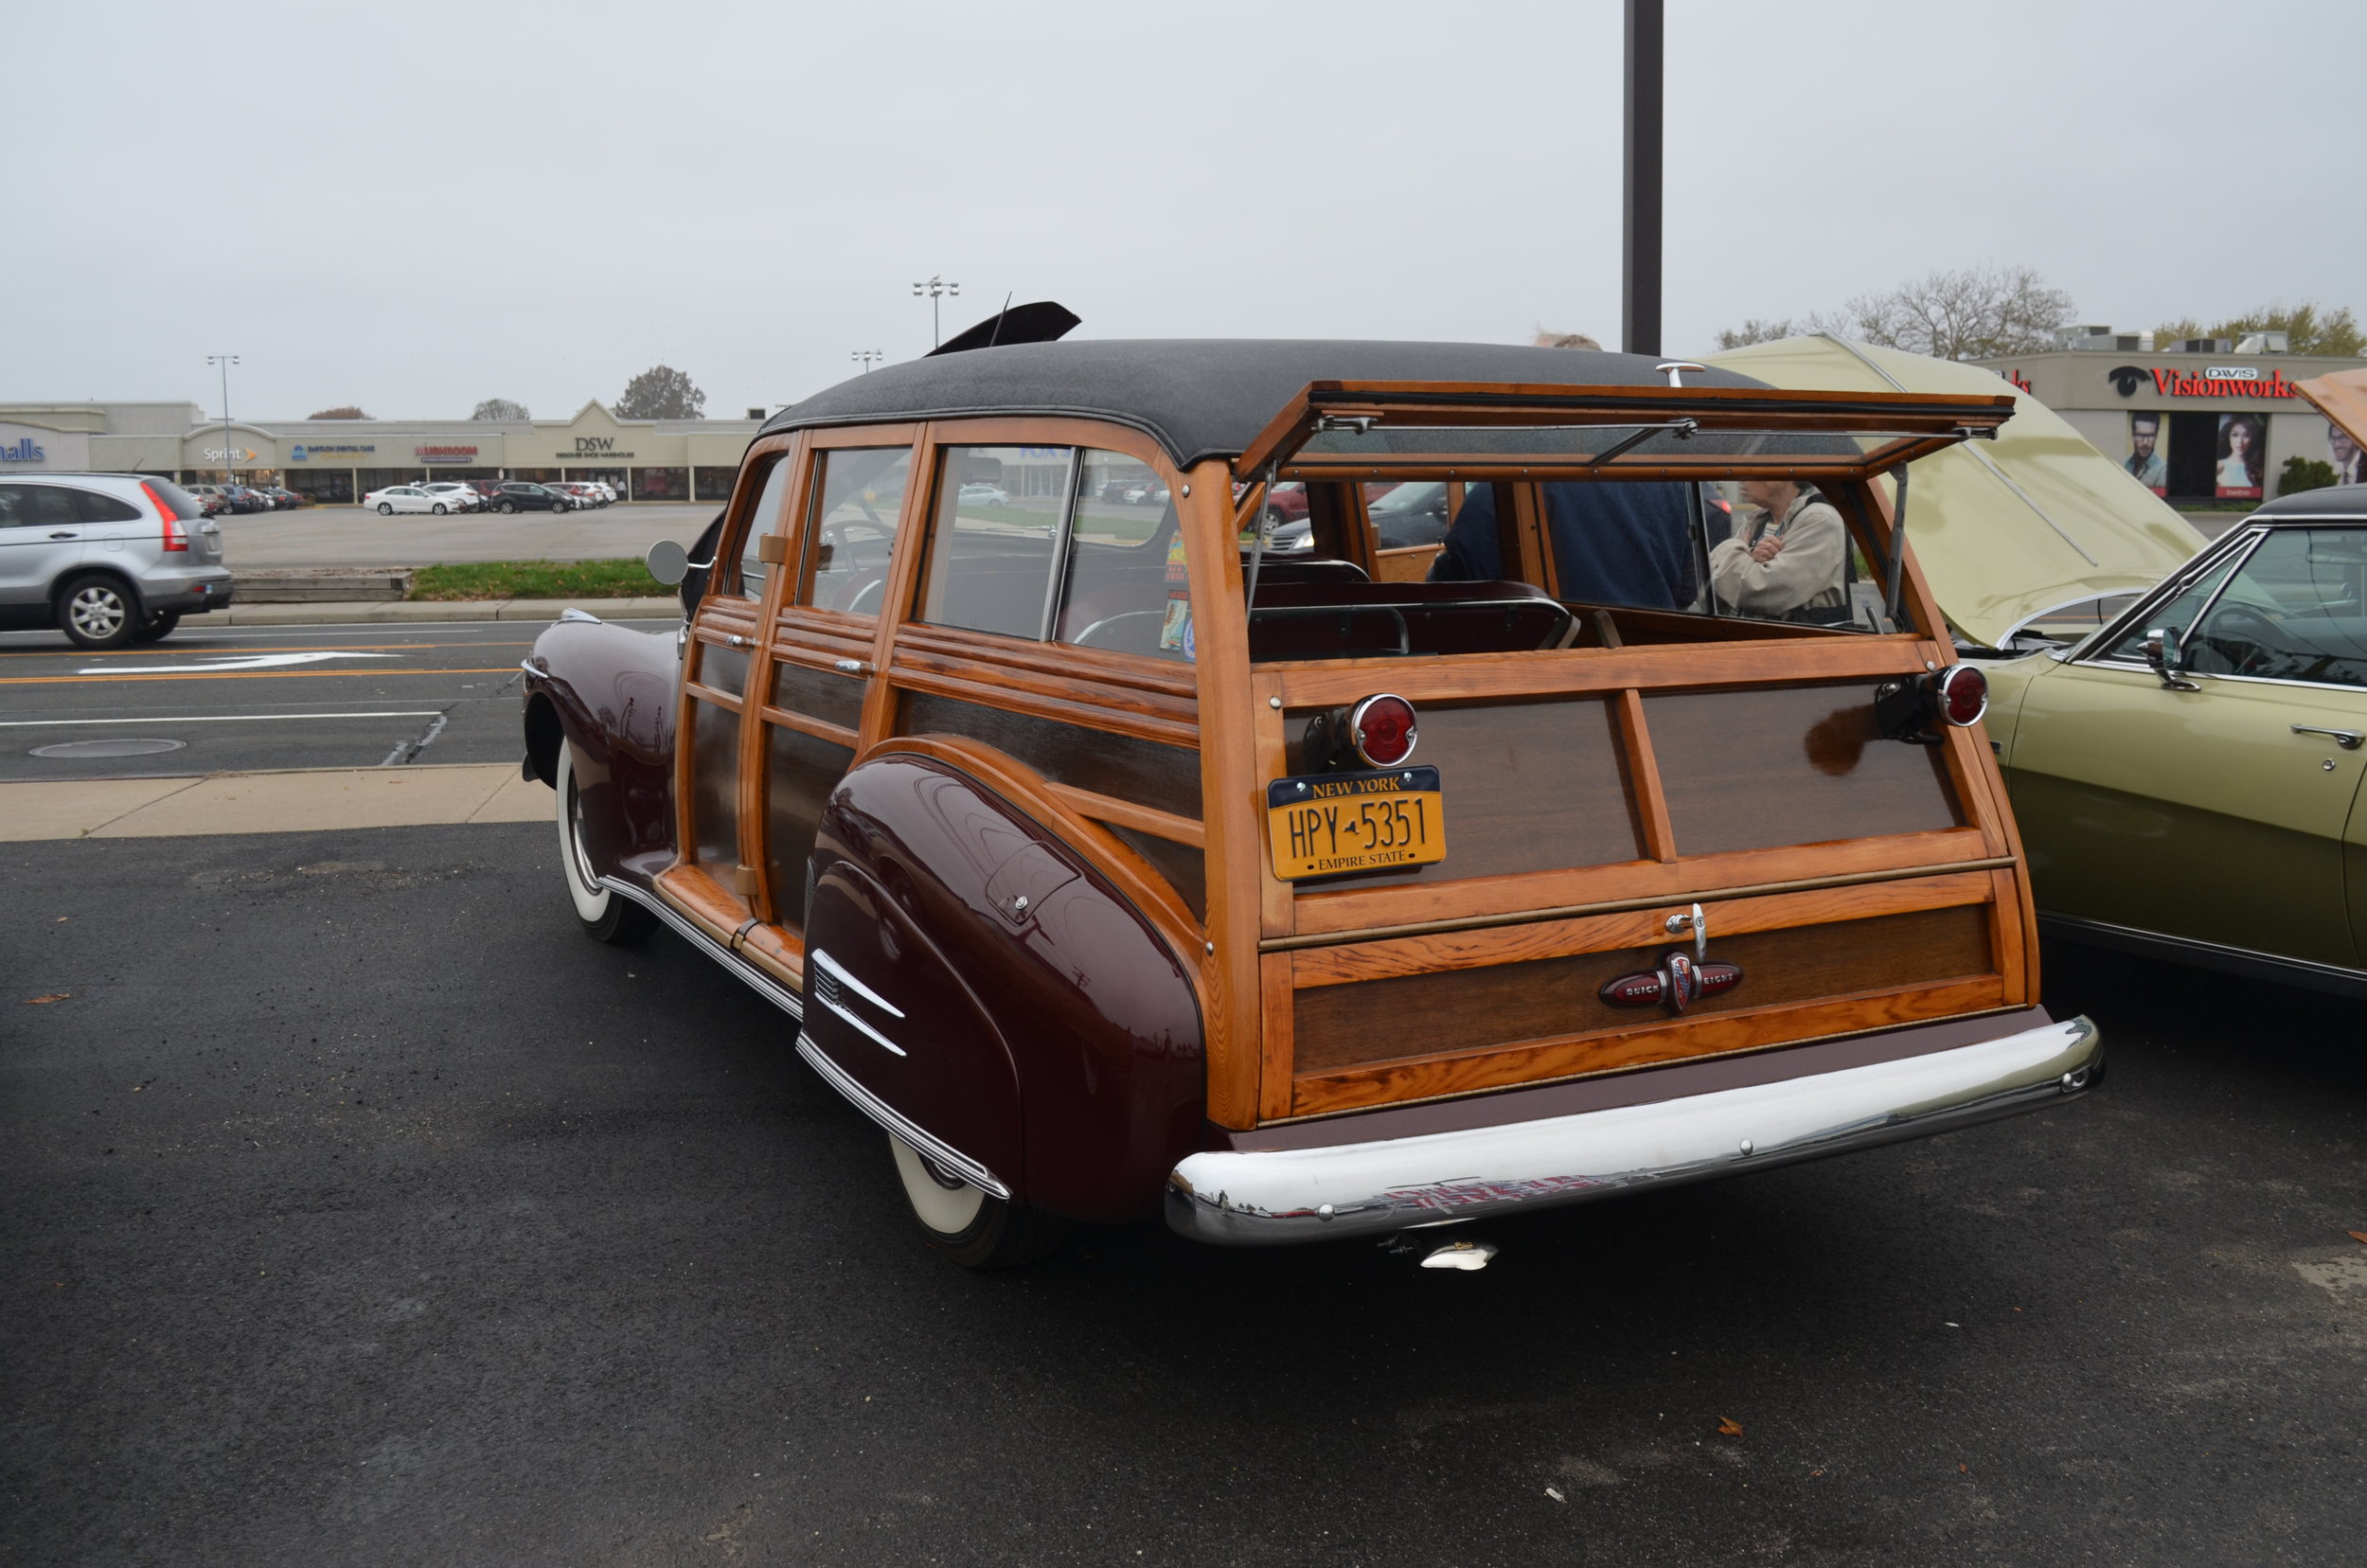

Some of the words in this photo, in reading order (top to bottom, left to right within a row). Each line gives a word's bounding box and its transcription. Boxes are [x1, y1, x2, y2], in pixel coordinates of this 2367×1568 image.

[2208, 368, 2255, 379] DAVIS
[204, 447, 241, 463] Sprint
[575, 437, 614, 452] DSW
[1312, 779, 1354, 799] NEW
[1359, 776, 1400, 793] YORK
[1289, 807, 1338, 859] HPY
[1361, 797, 1426, 849] 5351
[1319, 855, 1365, 871] EMPIRE
[1369, 849, 1406, 864] STATE
[1626, 985, 1660, 996] BUICK
[1703, 973, 1734, 985] EIGHT
